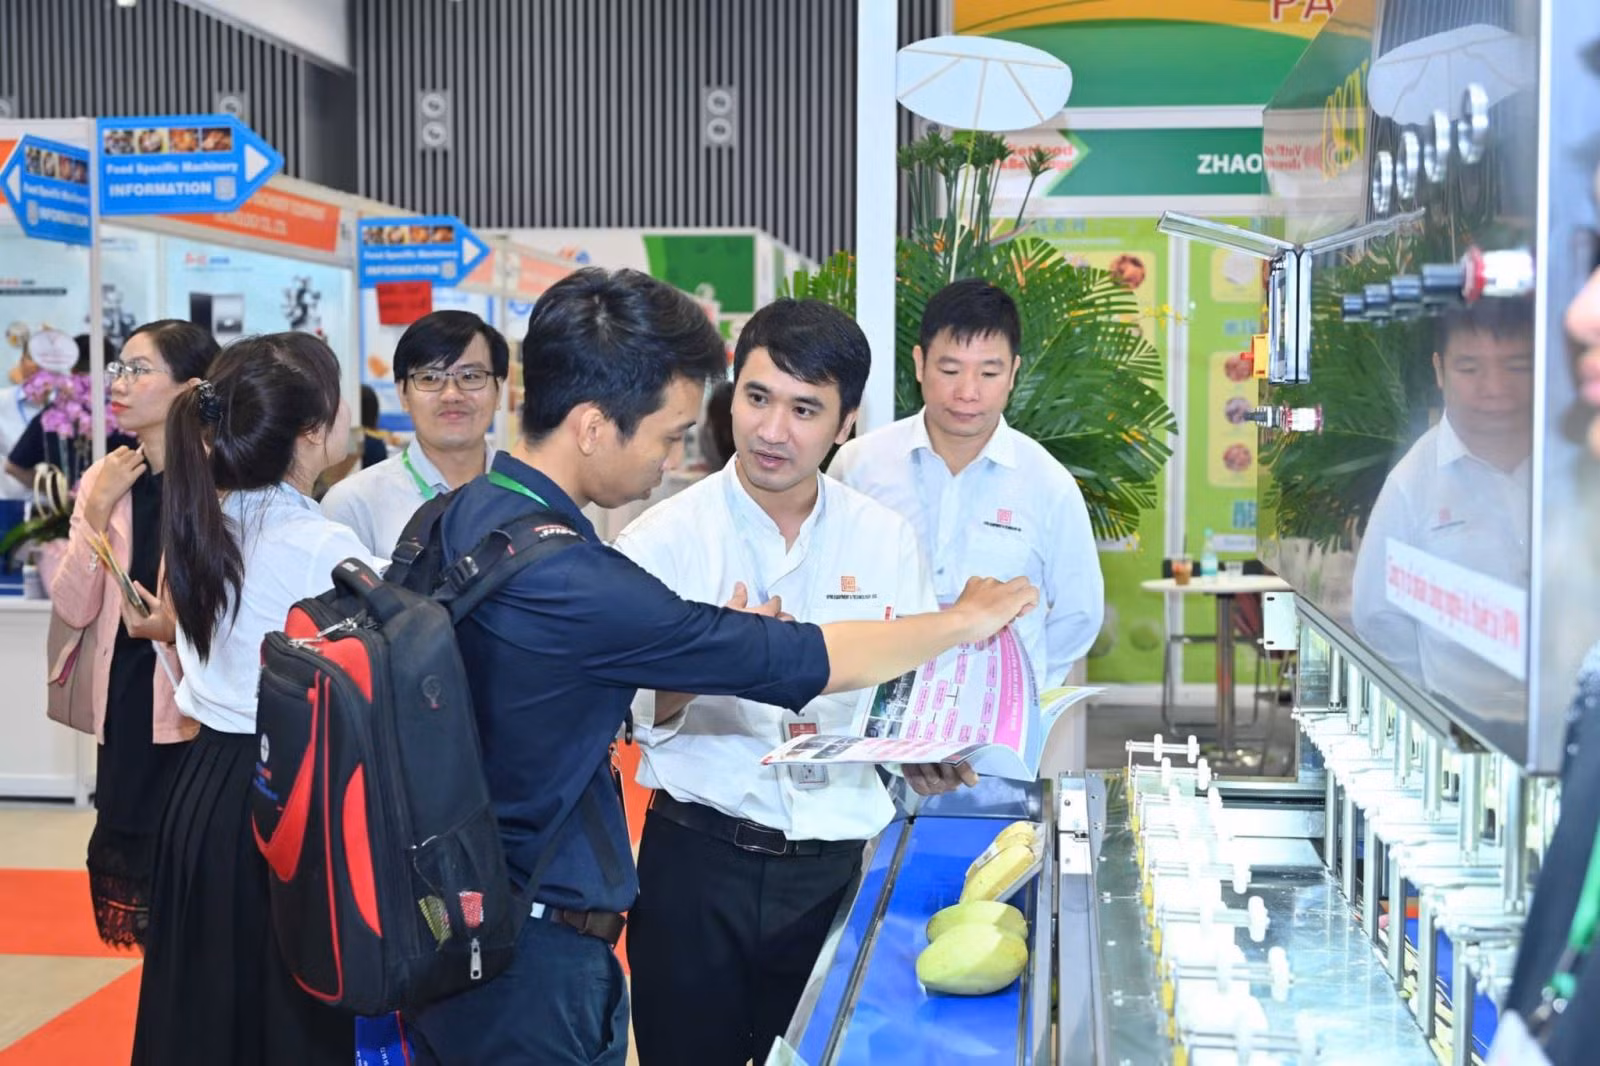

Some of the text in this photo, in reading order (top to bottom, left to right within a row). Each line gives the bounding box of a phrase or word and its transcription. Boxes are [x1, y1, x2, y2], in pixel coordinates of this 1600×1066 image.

[182, 160, 239, 174] Machinery
[1197, 153, 1263, 175] ZHAO
[109, 181, 212, 198] INFORMATION
[366, 264, 439, 277] INFORMATION
